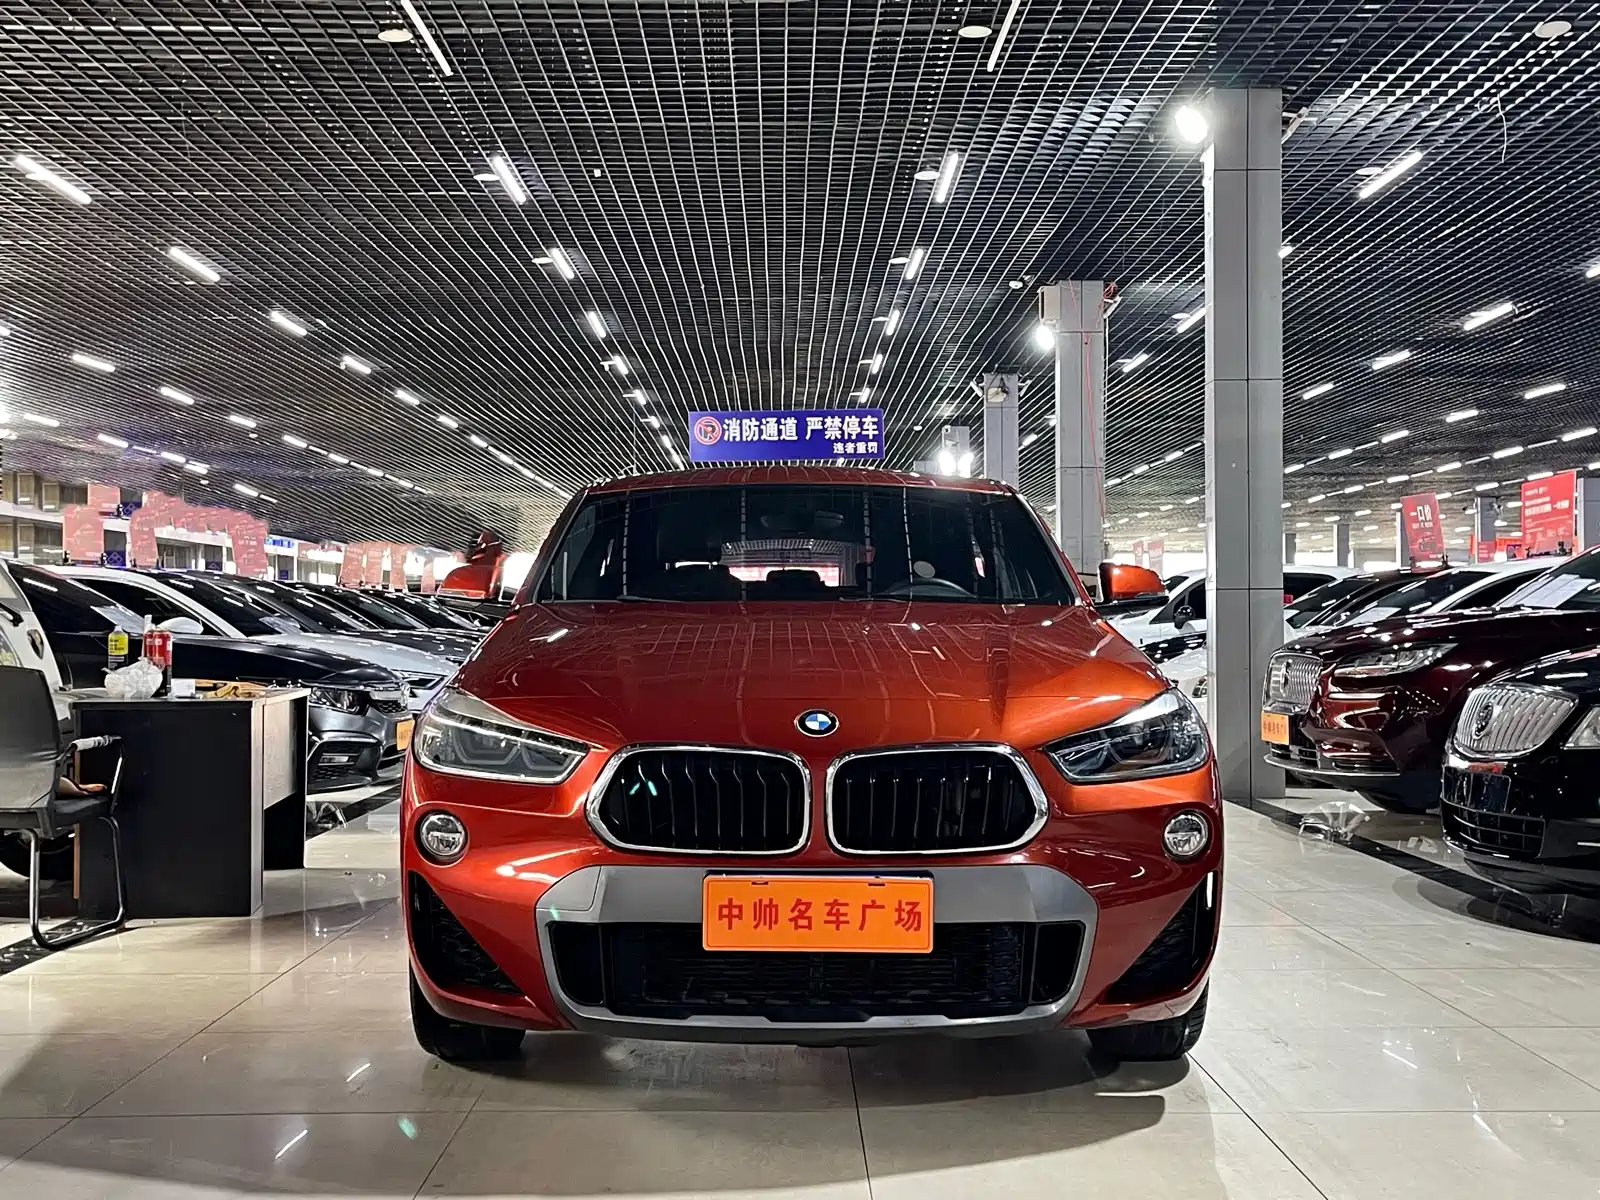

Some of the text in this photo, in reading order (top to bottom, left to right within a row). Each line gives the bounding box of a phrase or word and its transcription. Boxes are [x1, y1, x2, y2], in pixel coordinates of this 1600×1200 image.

[722, 415, 879, 441] 消防通道 严禁停车
[717, 897, 922, 932] 中帅名车广场
